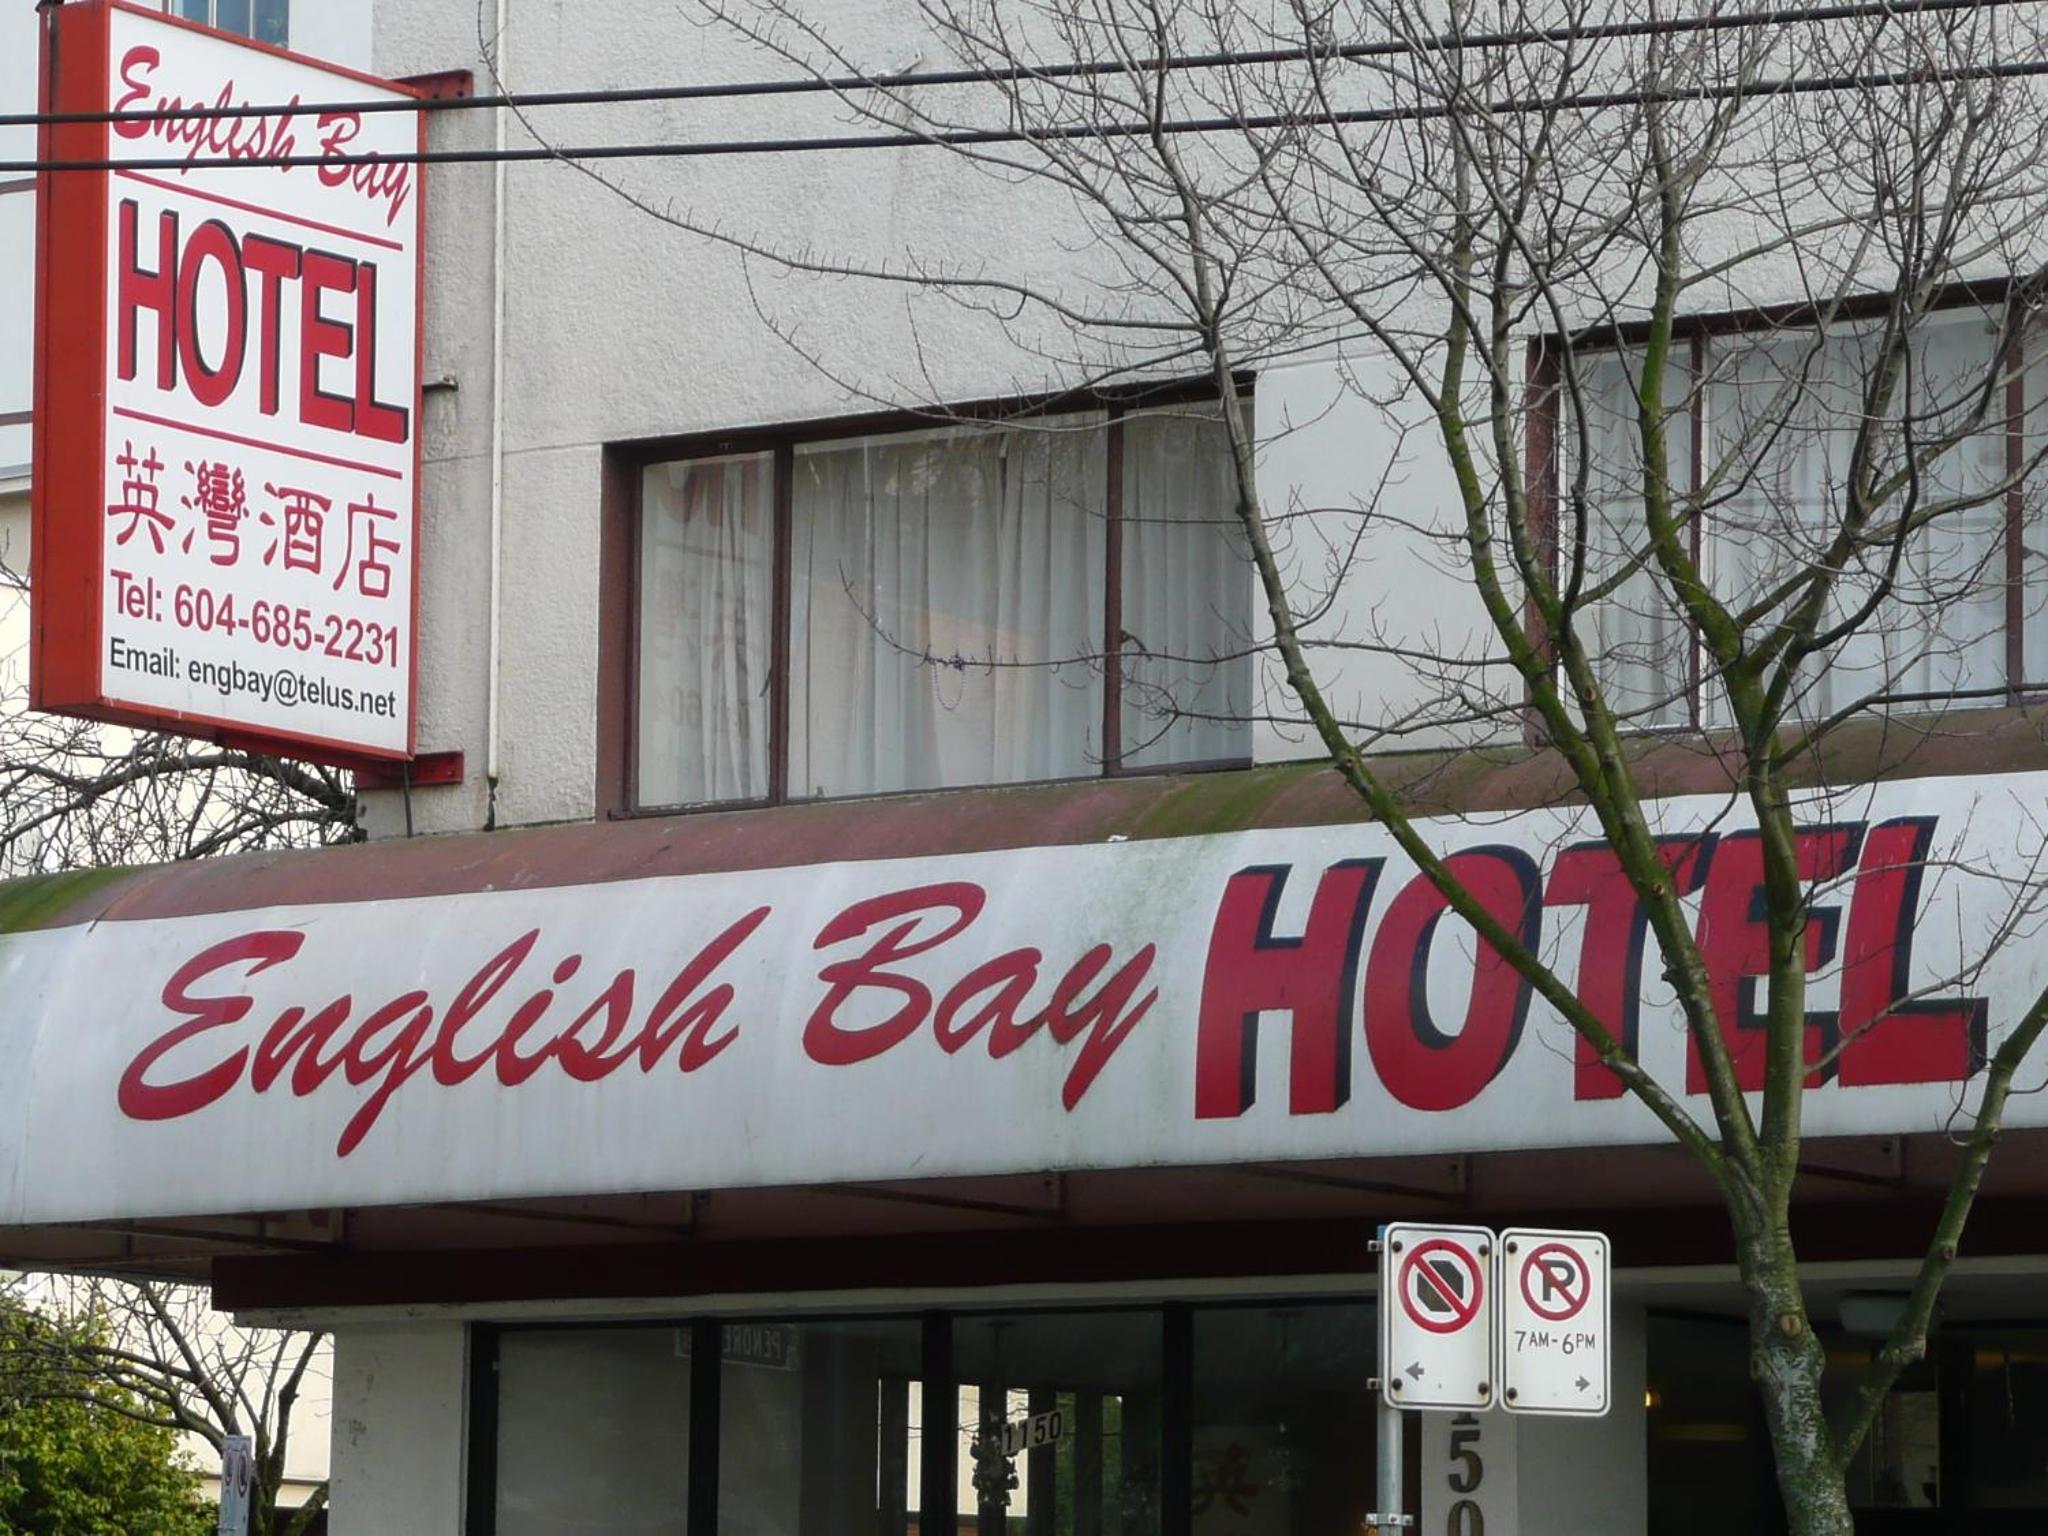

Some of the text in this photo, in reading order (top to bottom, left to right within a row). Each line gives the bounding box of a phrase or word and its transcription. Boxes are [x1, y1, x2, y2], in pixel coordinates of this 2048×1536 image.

[112, 46, 411, 226] English Bay
[118, 198, 409, 443] HOTEL
[108, 440, 400, 598] 英灣酒店
[110, 569, 398, 668] Tel: 604-685-2231
[110, 636, 396, 718] Email: engbay@telus.net
[118, 815, 1988, 1157] English Bay HOTEL
[1004, 1411, 1062, 1452] 1150
[1448, 1411, 1485, 1536] 50
